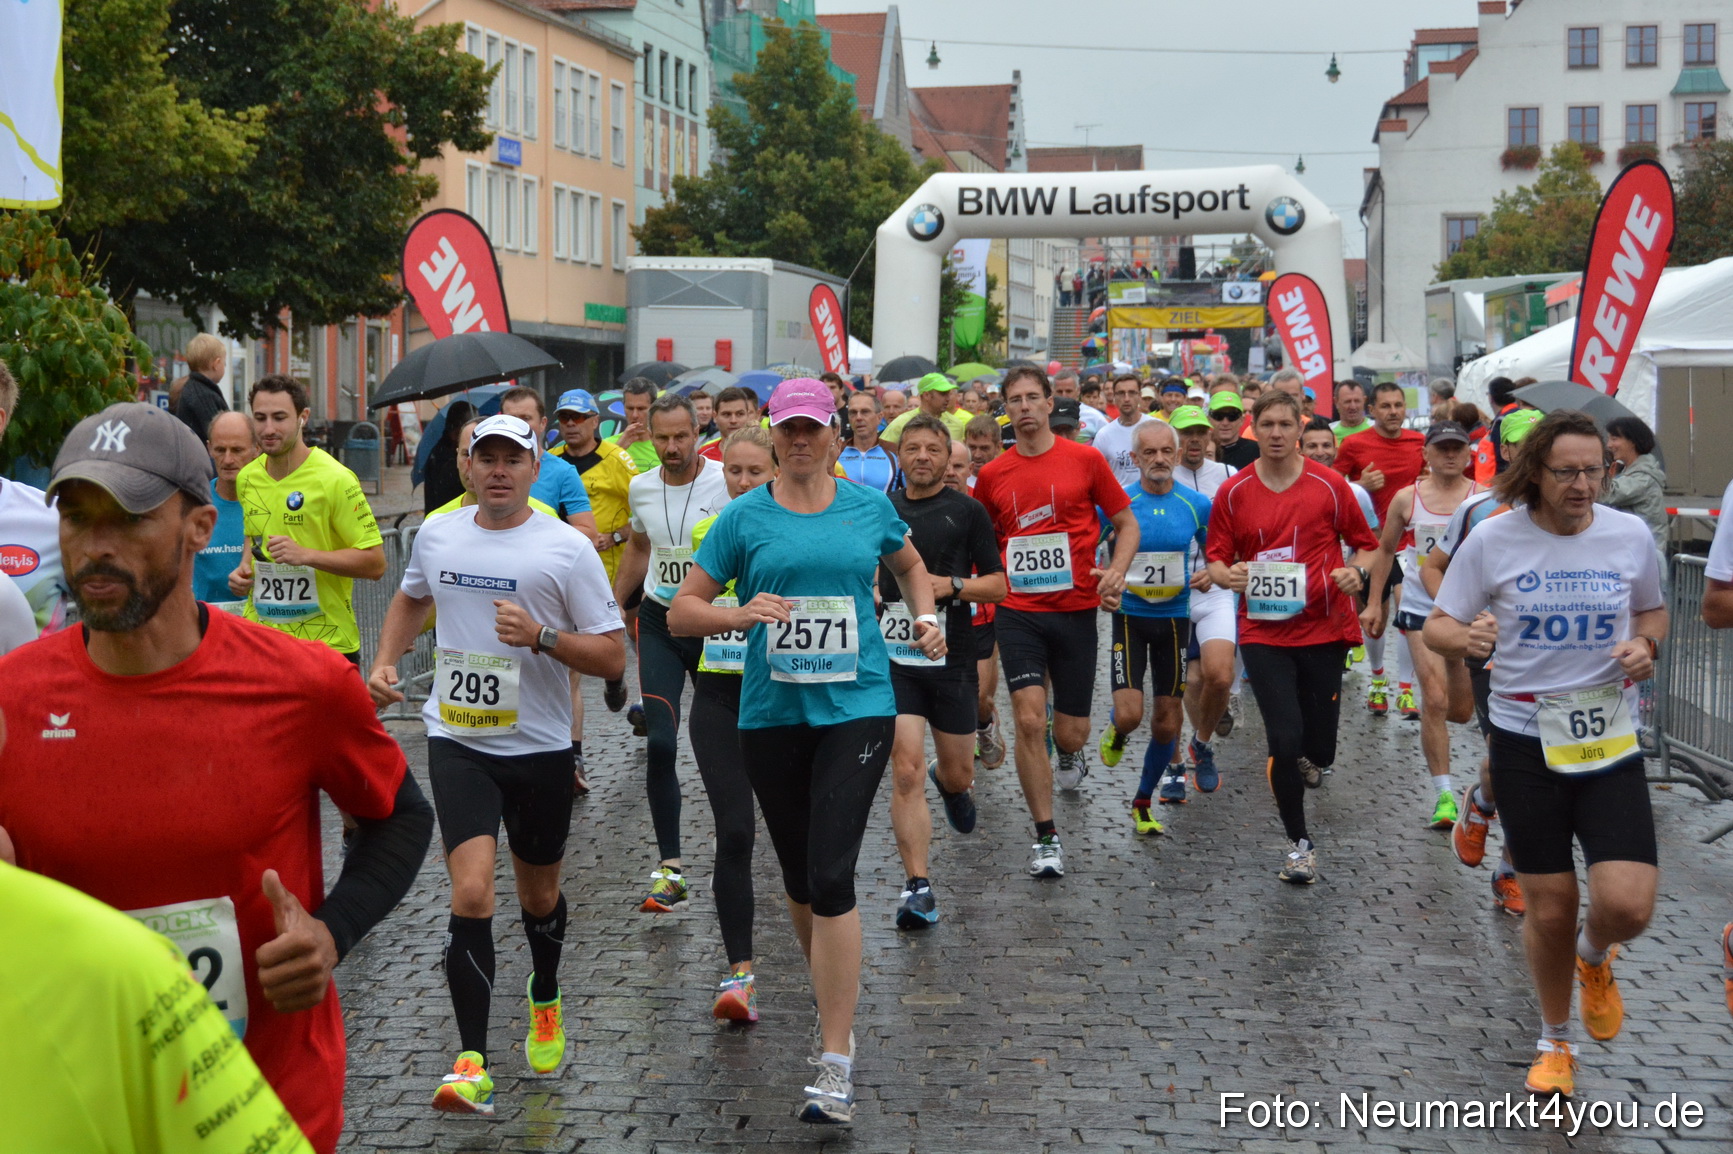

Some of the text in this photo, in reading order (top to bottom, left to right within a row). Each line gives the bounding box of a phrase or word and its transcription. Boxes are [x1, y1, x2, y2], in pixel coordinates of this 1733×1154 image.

[958, 184, 1251, 220] BMW Laufsport
[1579, 193, 1662, 395] REWE
[1170, 311, 1204, 324] ZIEL
[89, 420, 132, 453] NY
[284, 513, 304, 522] Partl
[1028, 511, 1043, 522] DEHN
[1013, 548, 1065, 572] 2588
[1266, 552, 1282, 560] DEHN
[1023, 575, 1057, 586] Berthold
[1144, 565, 1166, 584] 21
[260, 577, 312, 601] 2872
[461, 576, 514, 589] BÜSCHEL
[1251, 576, 1297, 597] 2551
[1545, 582, 1622, 593] STIFTUNG
[1145, 588, 1164, 597] Willi
[266, 606, 308, 616] Johannes
[807, 599, 849, 610] BOCK
[1259, 603, 1288, 612] Markus
[1515, 602, 1622, 612] 17. Altstadtfestlauf
[776, 618, 848, 649] 2571
[1518, 614, 1616, 642] 2015
[721, 648, 742, 660] Nina
[791, 658, 833, 673] Sibylle
[449, 670, 500, 706] 293
[447, 708, 499, 728] Wolfgang
[1569, 707, 1606, 739] 65
[42, 728, 77, 739] erima
[1580, 746, 1605, 760] Jörg
[142, 907, 218, 935] OCK
[195, 1103, 240, 1140] BMW
